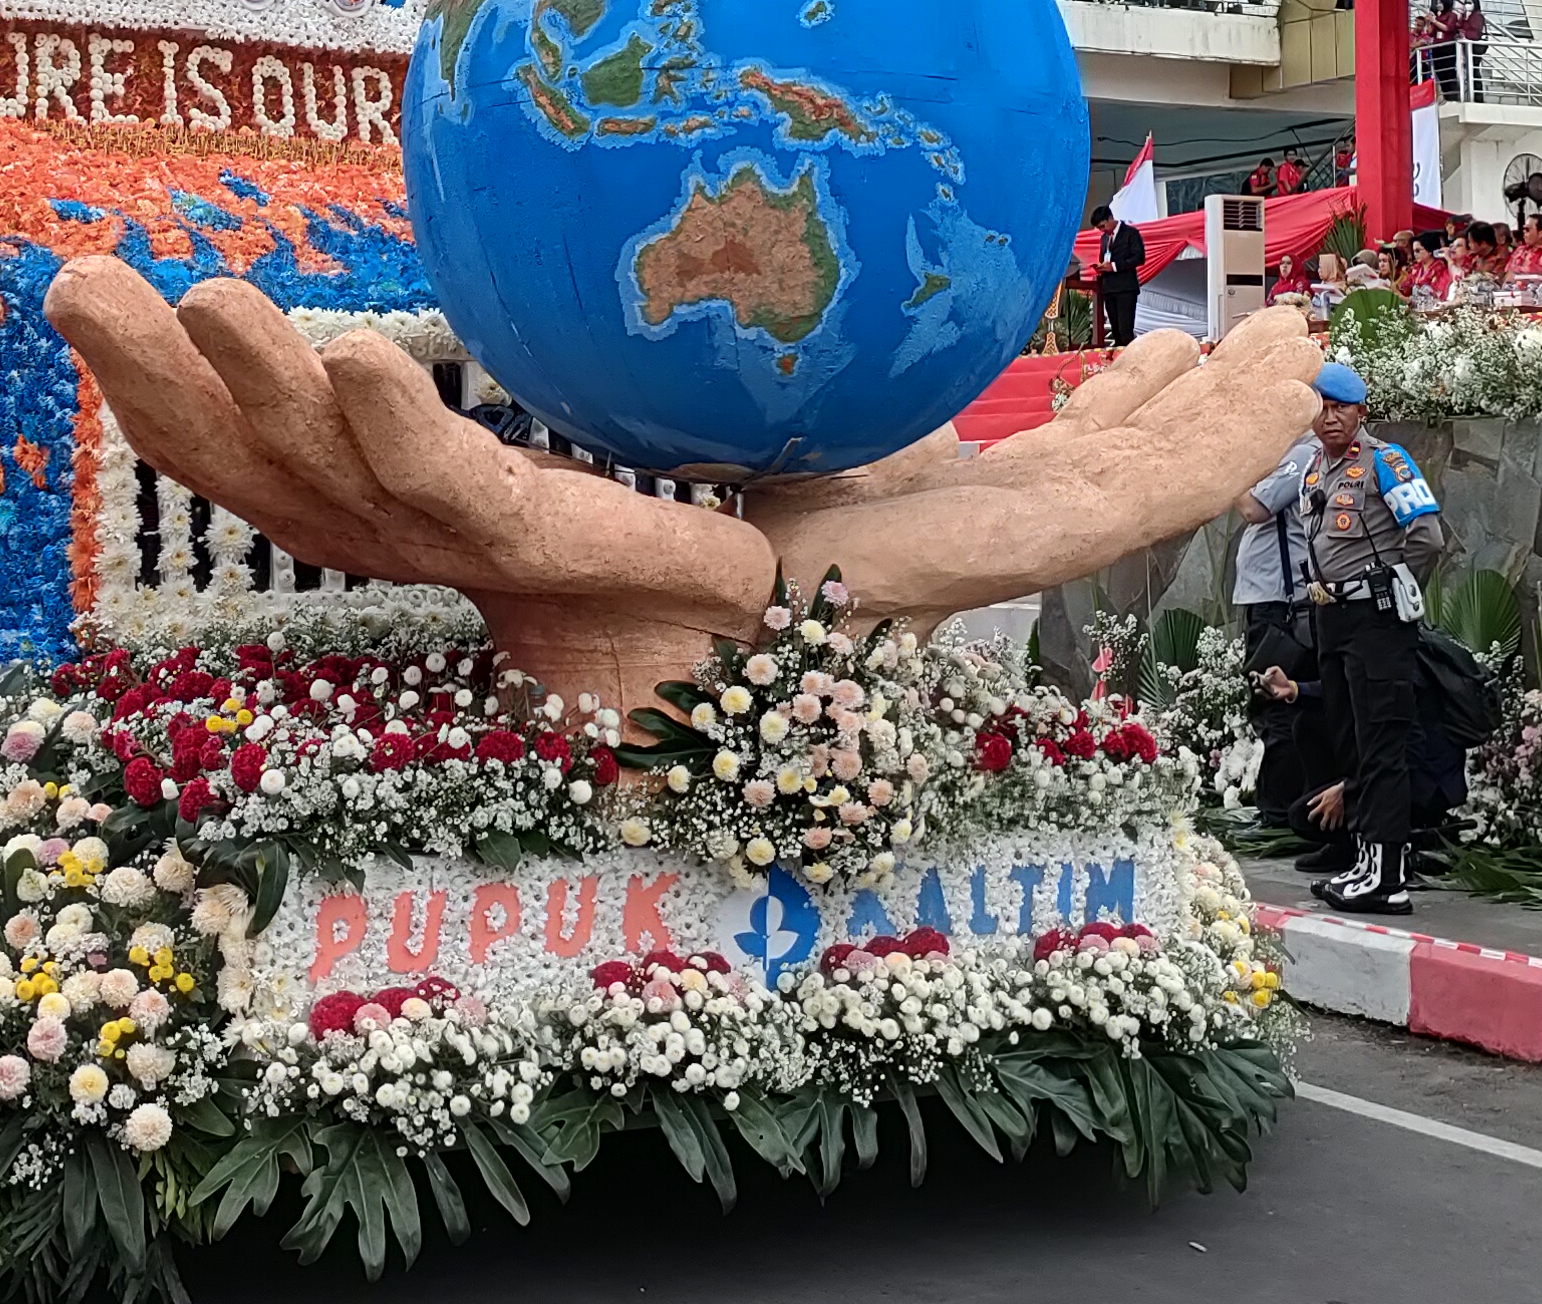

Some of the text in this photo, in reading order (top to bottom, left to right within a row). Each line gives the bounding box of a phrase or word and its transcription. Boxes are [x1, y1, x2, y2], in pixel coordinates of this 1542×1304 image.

[157, 38, 233, 134] IS
[251, 53, 402, 147] OUR
[1338, 480, 1365, 490] POLRI
[308, 871, 681, 983] PUPUK
